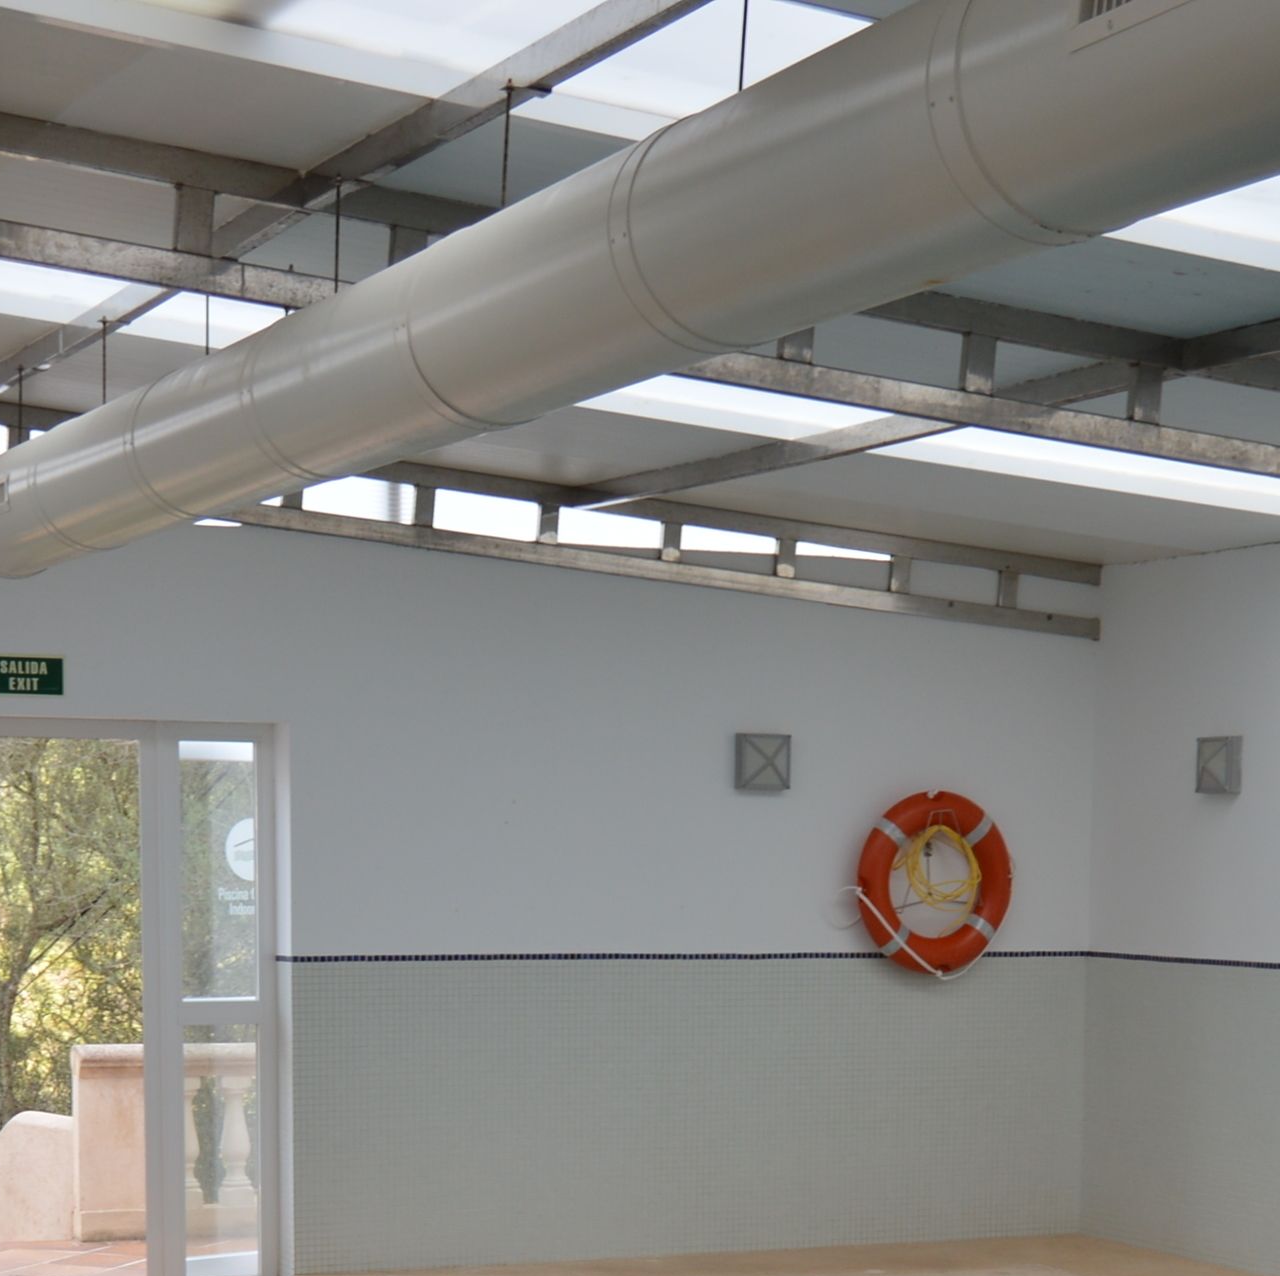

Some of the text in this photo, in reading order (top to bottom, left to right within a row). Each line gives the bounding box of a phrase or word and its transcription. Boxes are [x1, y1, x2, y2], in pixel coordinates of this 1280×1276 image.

[0, 661, 48, 675] SALIDA
[9, 678, 39, 691] EXIT
[218, 888, 249, 902] Piscina
